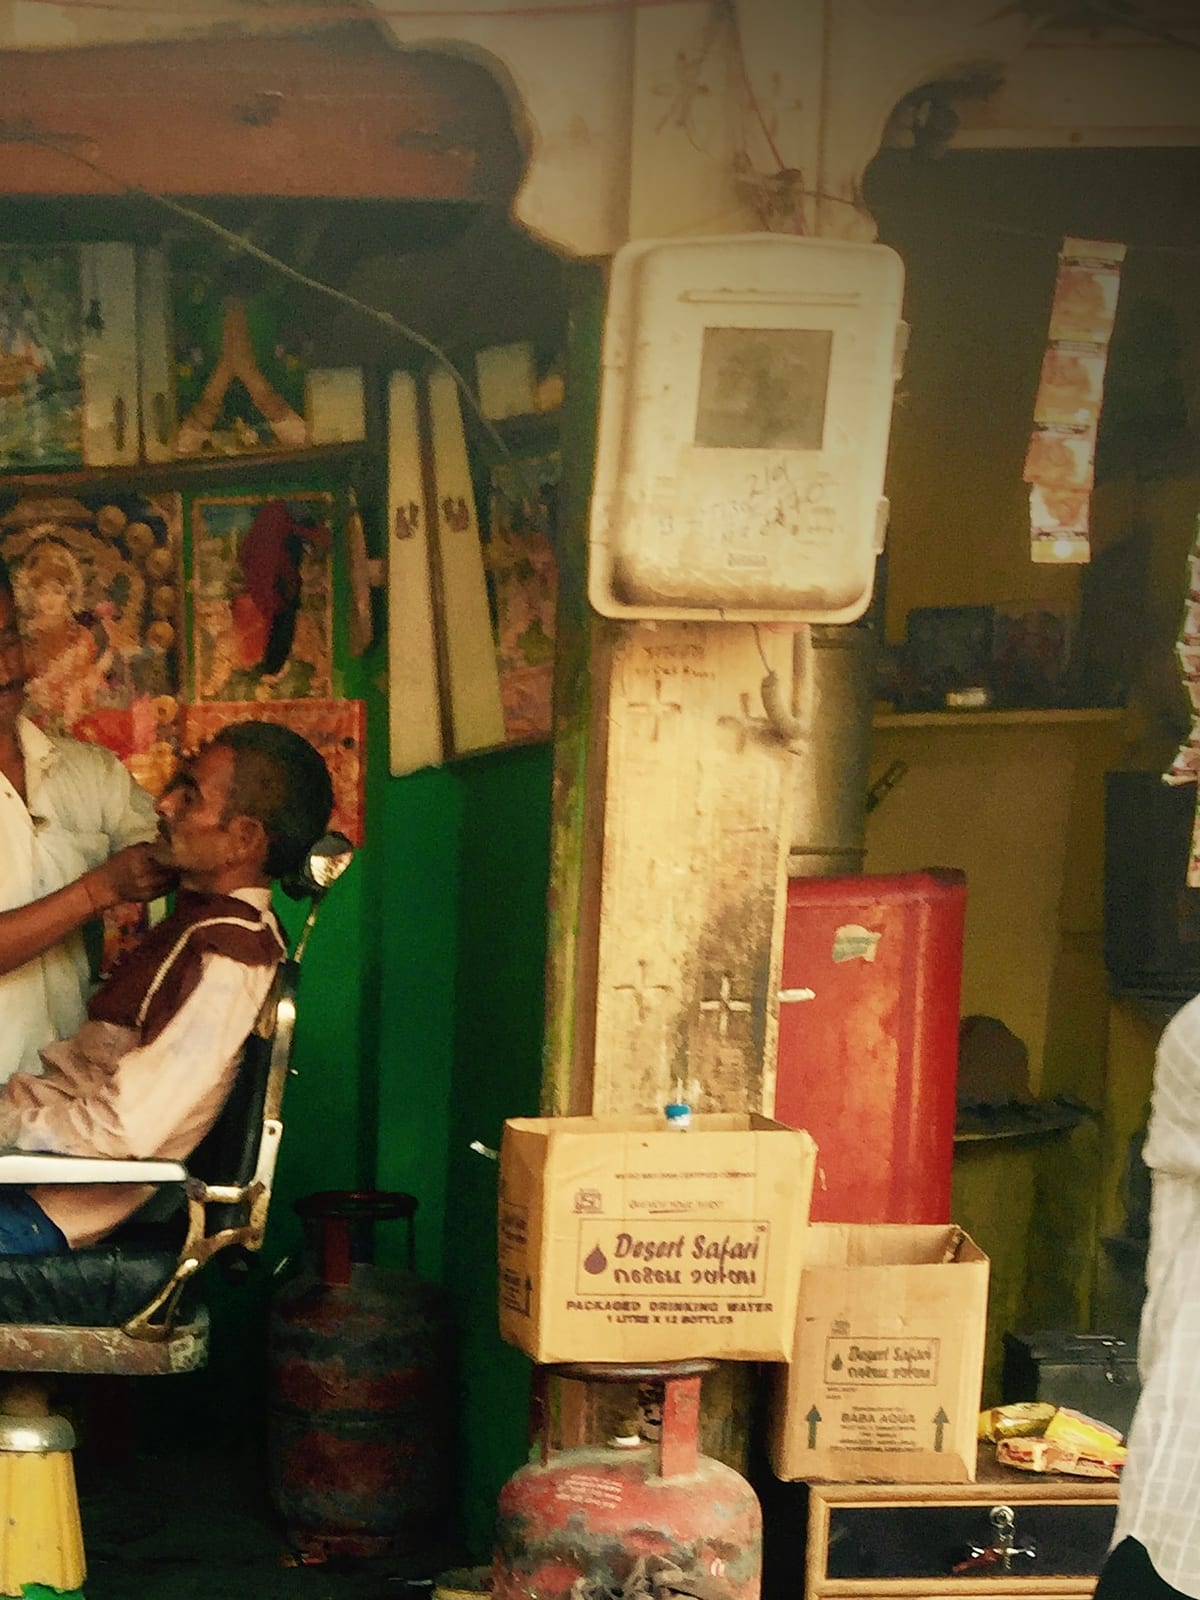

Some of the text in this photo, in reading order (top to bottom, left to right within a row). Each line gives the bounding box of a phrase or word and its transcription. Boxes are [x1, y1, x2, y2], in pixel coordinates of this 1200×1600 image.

[614, 1232, 760, 1273] Desert Safari
[566, 1301, 774, 1312] PACKAGED DRINKING WATER
[681, 1315, 734, 1324] BOTTLES
